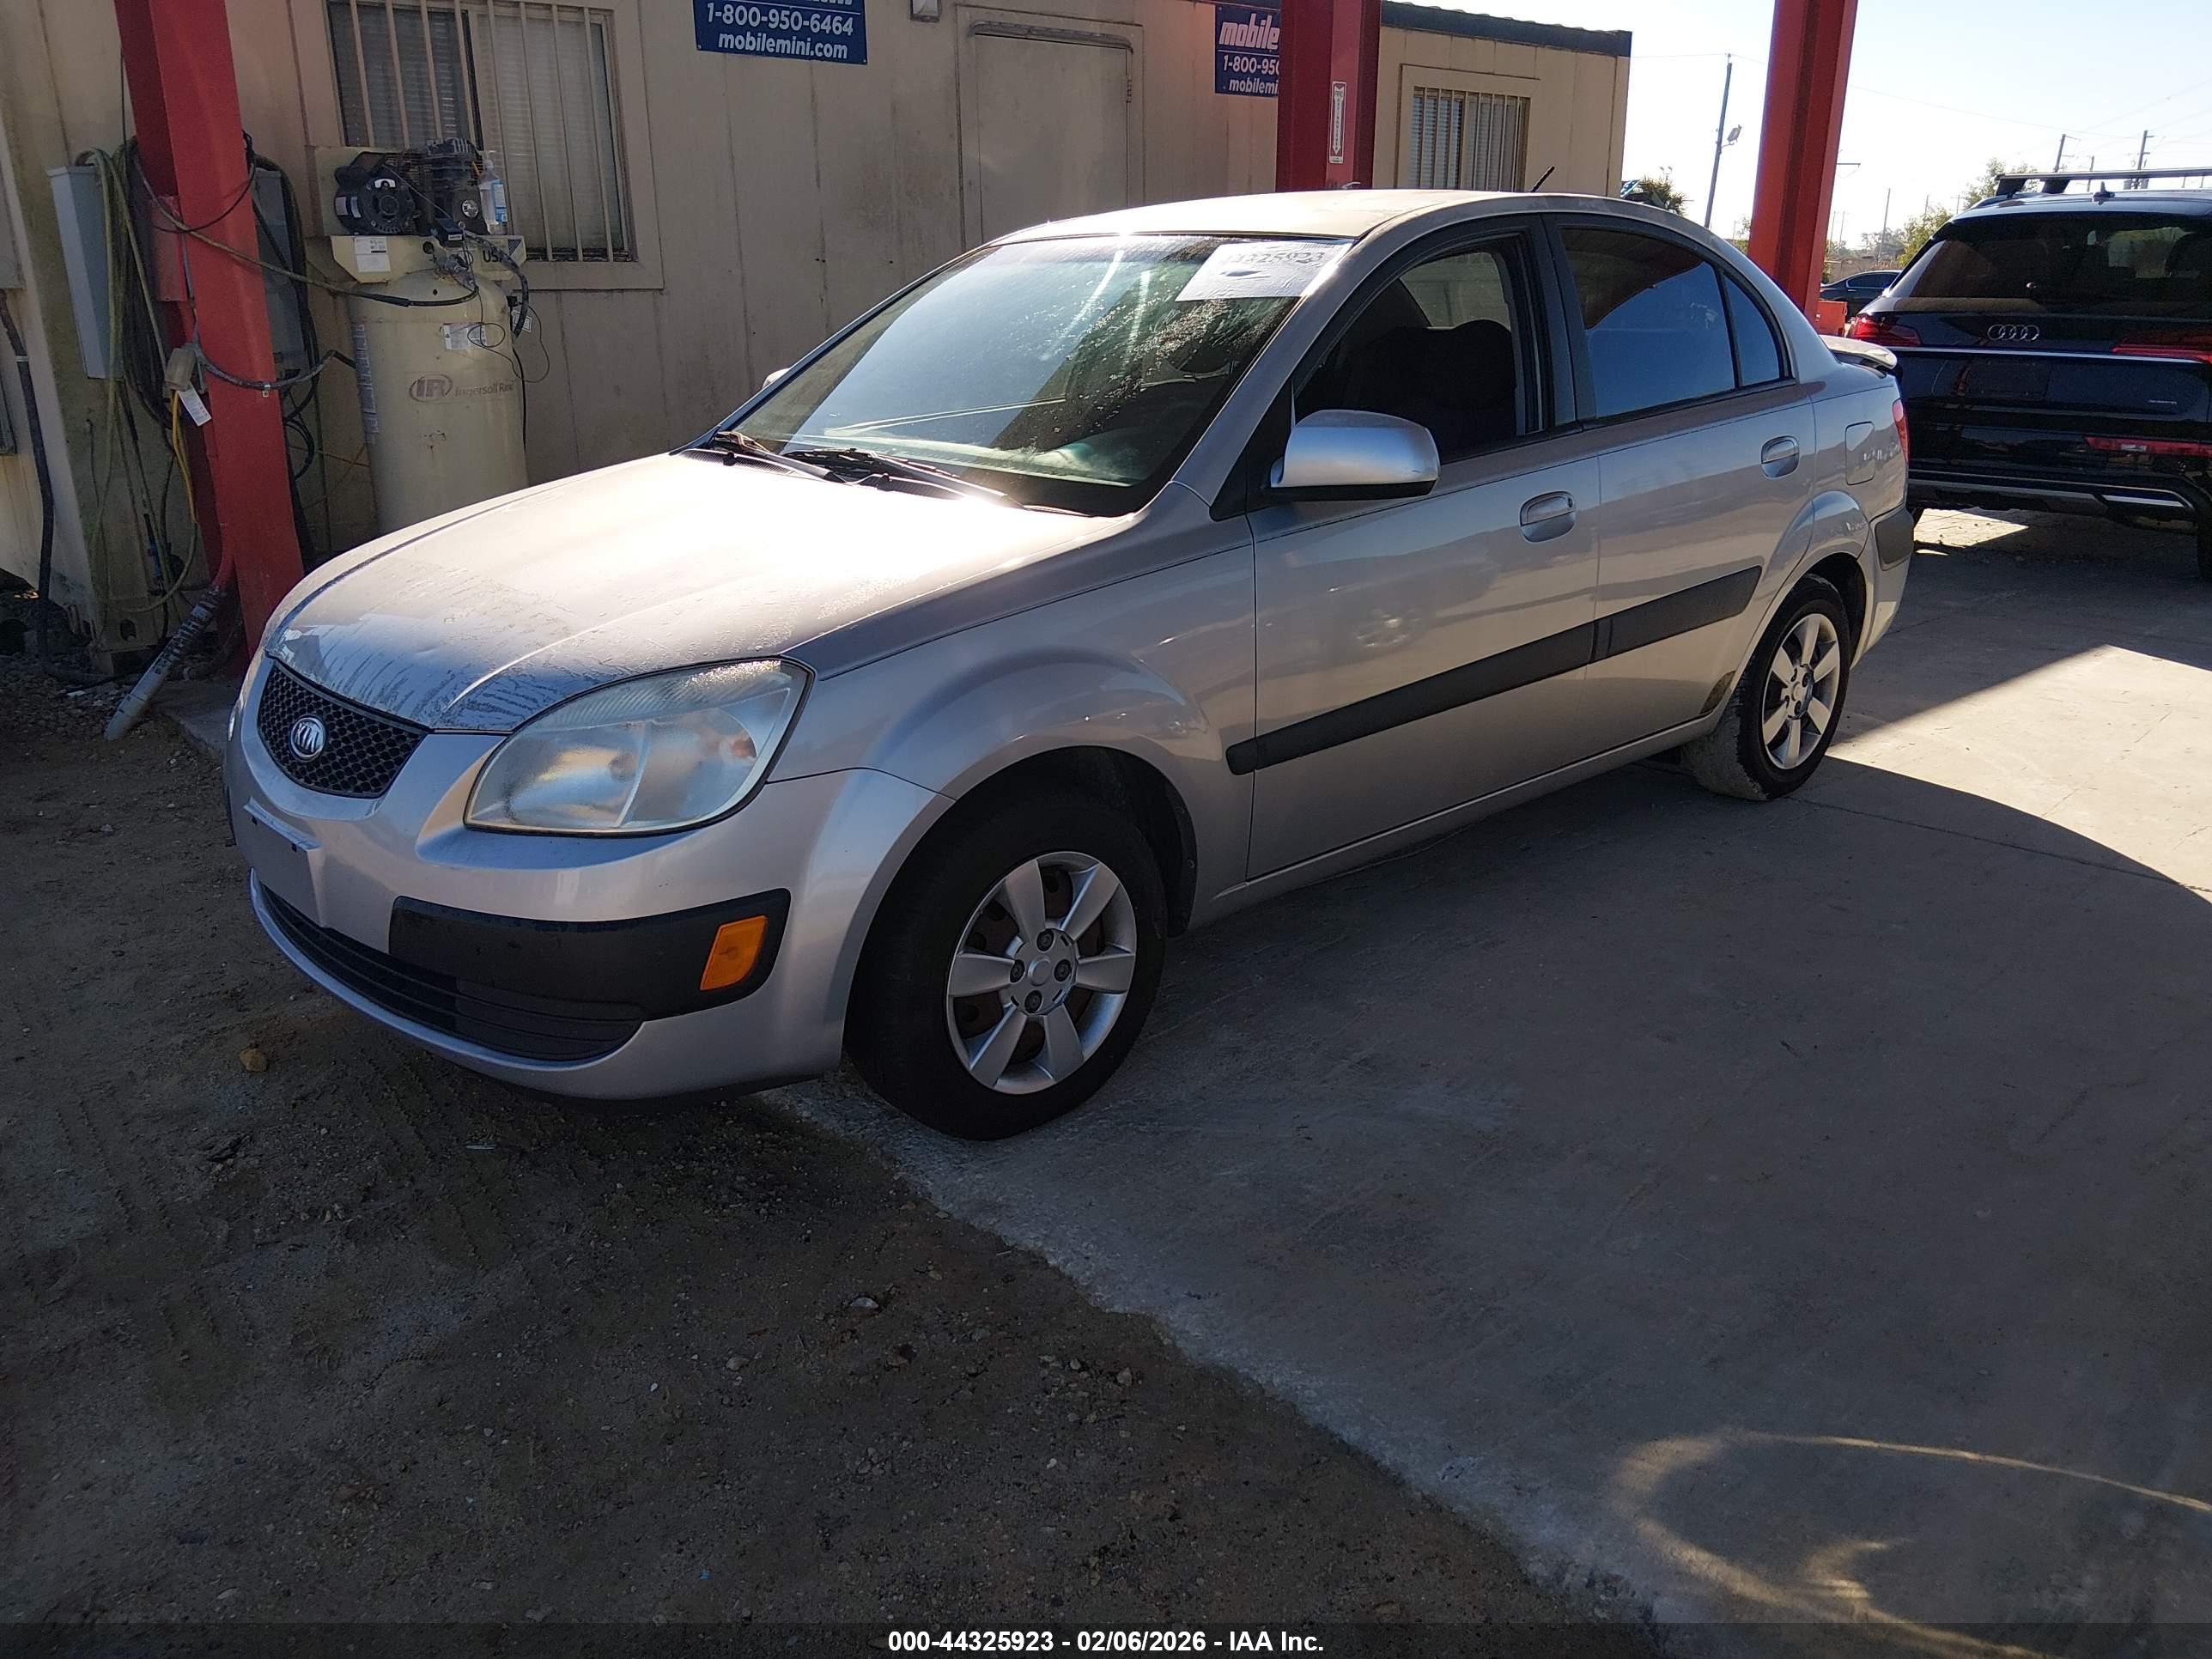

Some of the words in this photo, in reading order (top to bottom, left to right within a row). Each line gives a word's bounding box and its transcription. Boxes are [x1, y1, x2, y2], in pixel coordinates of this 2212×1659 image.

[707, 3, 854, 36] 1-800-950-6464
[1218, 13, 1280, 50] mobile
[718, 31, 848, 59] mobilemini.com
[482, 249, 502, 263] US
